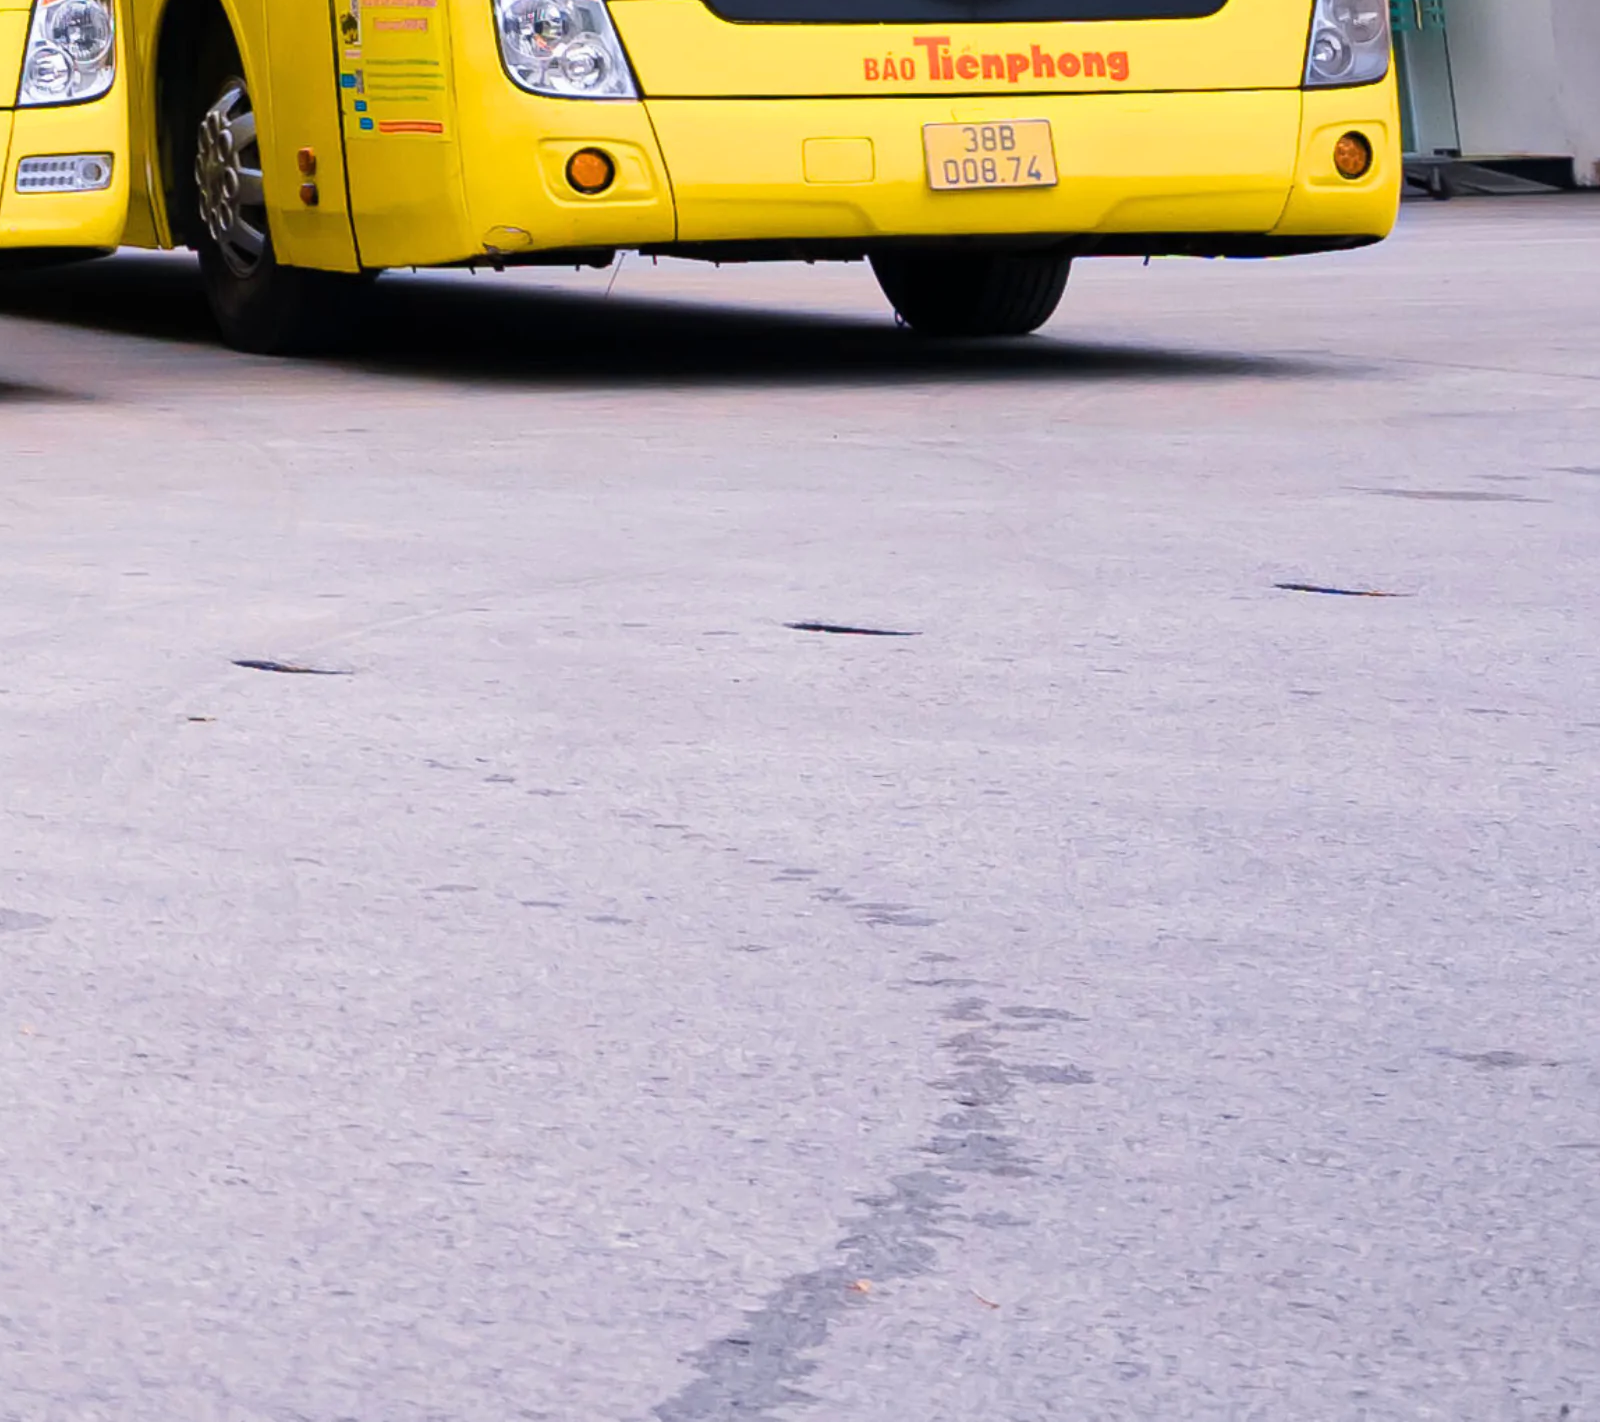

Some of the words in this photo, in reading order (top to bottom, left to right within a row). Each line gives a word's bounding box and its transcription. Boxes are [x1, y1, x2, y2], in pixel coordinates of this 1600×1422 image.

[863, 51, 916, 81] BÁO
[962, 125, 1015, 152] 38B
[943, 155, 1042, 184] 008.74
